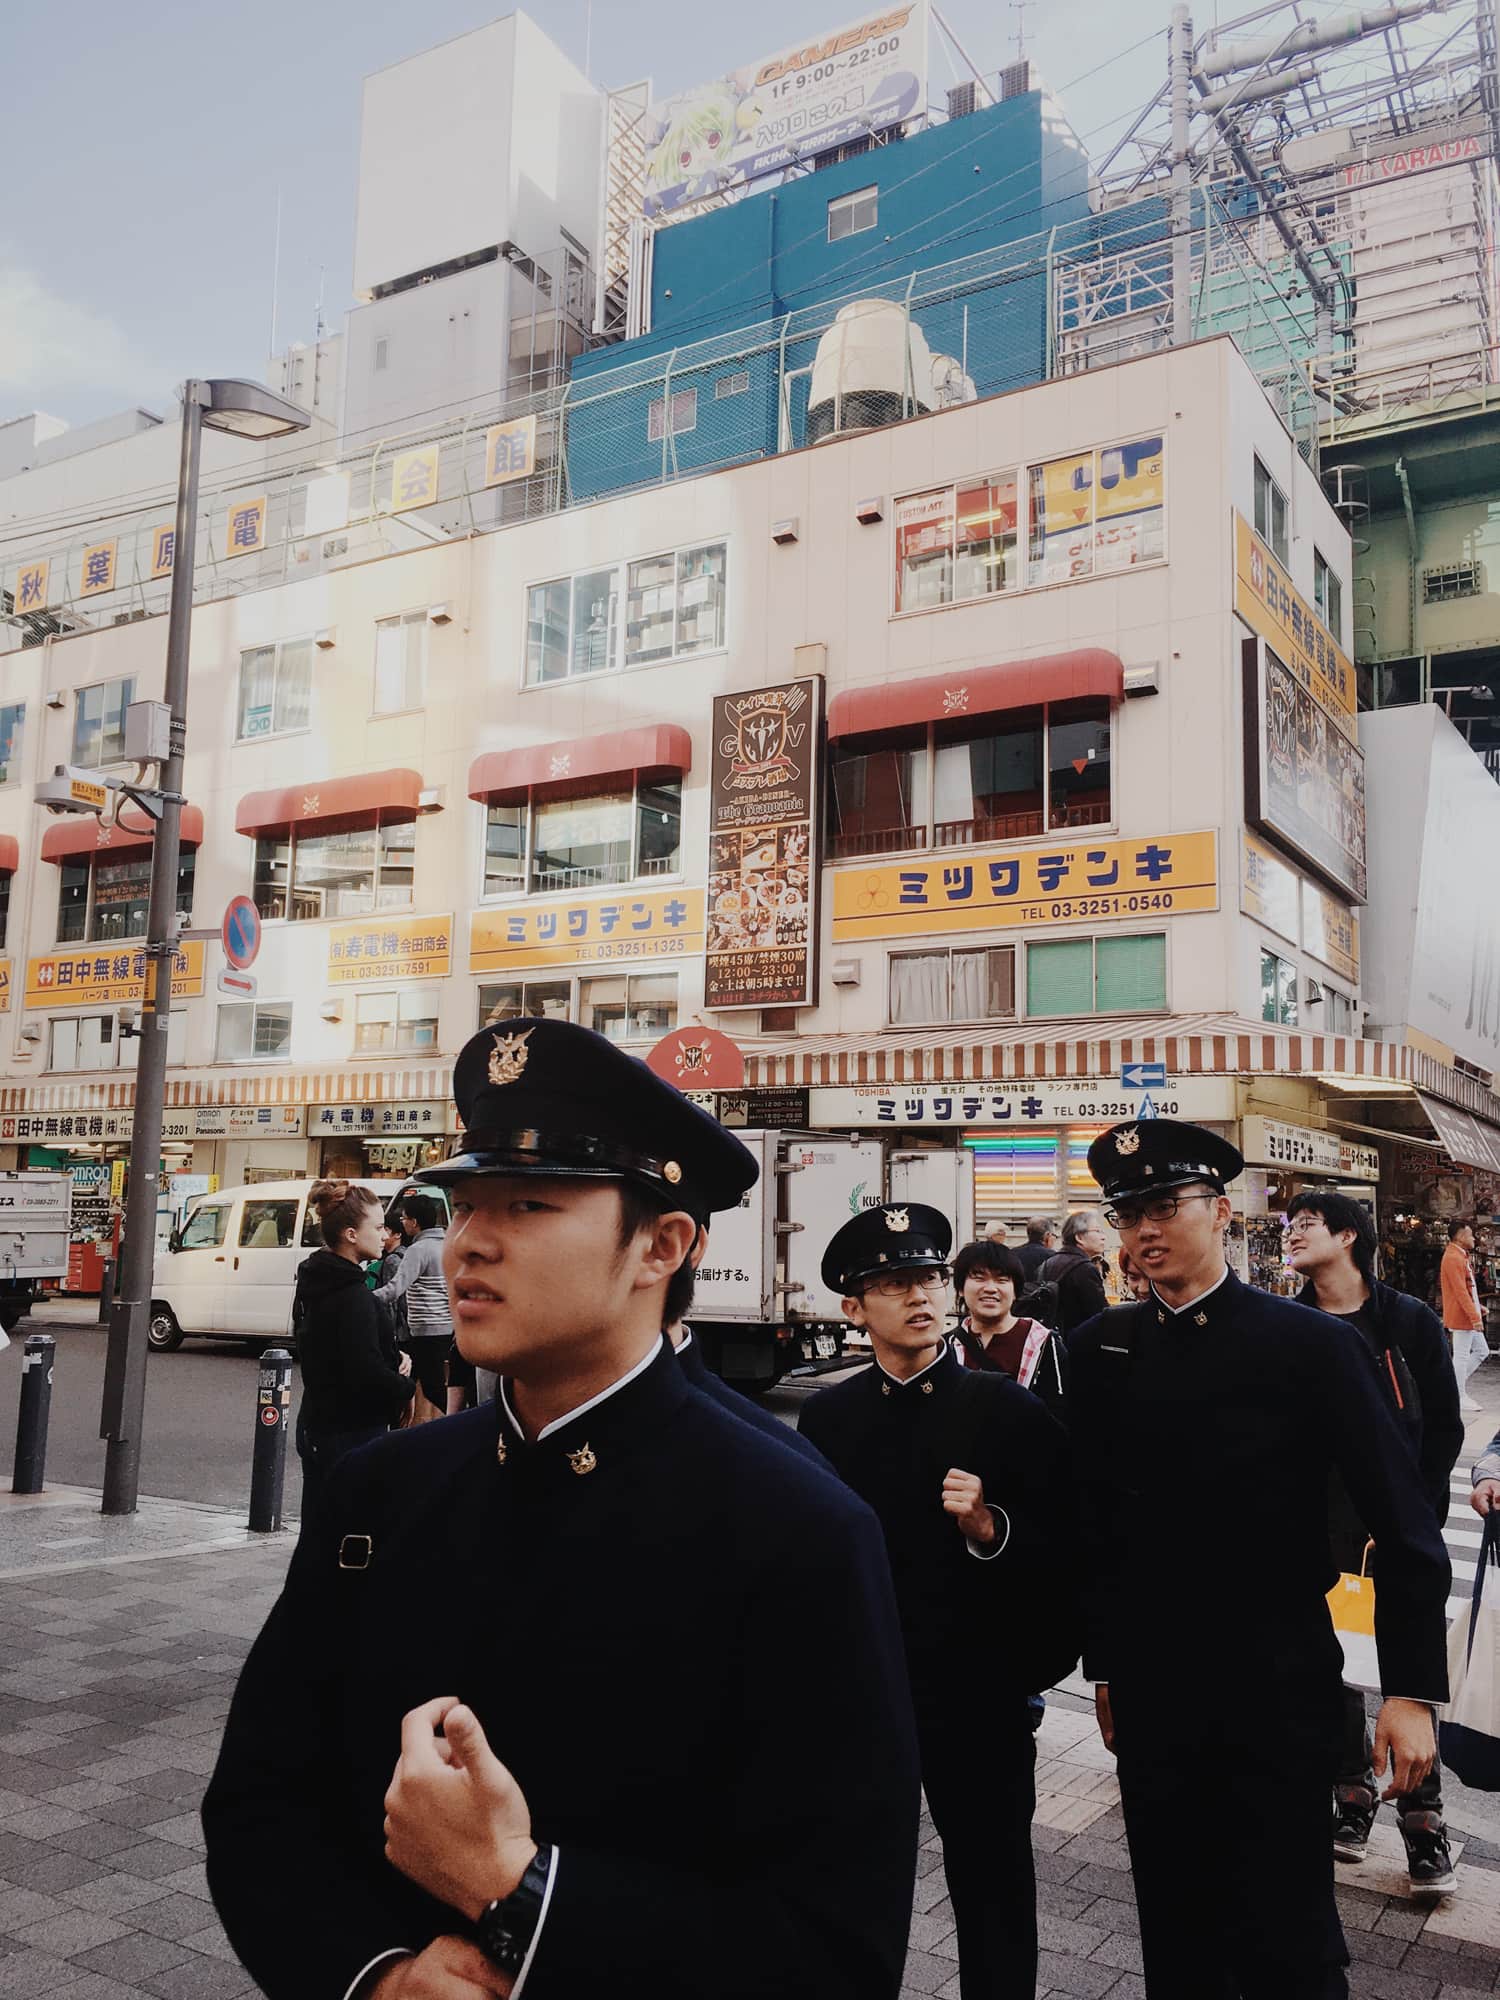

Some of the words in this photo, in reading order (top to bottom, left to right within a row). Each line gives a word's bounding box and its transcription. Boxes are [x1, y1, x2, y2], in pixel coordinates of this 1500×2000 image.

[755, 7, 912, 86] GAMERS
[772, 80, 791, 98] 1F
[898, 844, 1173, 904] ミツワデンキ
[1021, 907, 1046, 920] TEL
[1051, 893, 1173, 919] 03-3251-0540
[507, 899, 687, 942] ミツワデンキ
[575, 948, 593, 959] TEL
[597, 938, 685, 957] 03-3251-1325
[341, 968, 355, 978] TEL
[359, 961, 430, 978] 03-3251-7591
[718, 963, 797, 979] 12:00~23:00
[113, 988, 126, 998] TEL
[853, 1087, 891, 1097] TOSHIBA
[911, 1087, 927, 1095] LED
[383, 1109, 432, 1121] 会田商会
[877, 1096, 1043, 1121] ミツワデンキ
[1053, 1106, 1074, 1116] TEL
[1078, 1101, 1179, 1116] 03-3251540
[119, 1127, 132, 1136] TEL
[195, 1127, 226, 1135] Panasonic
